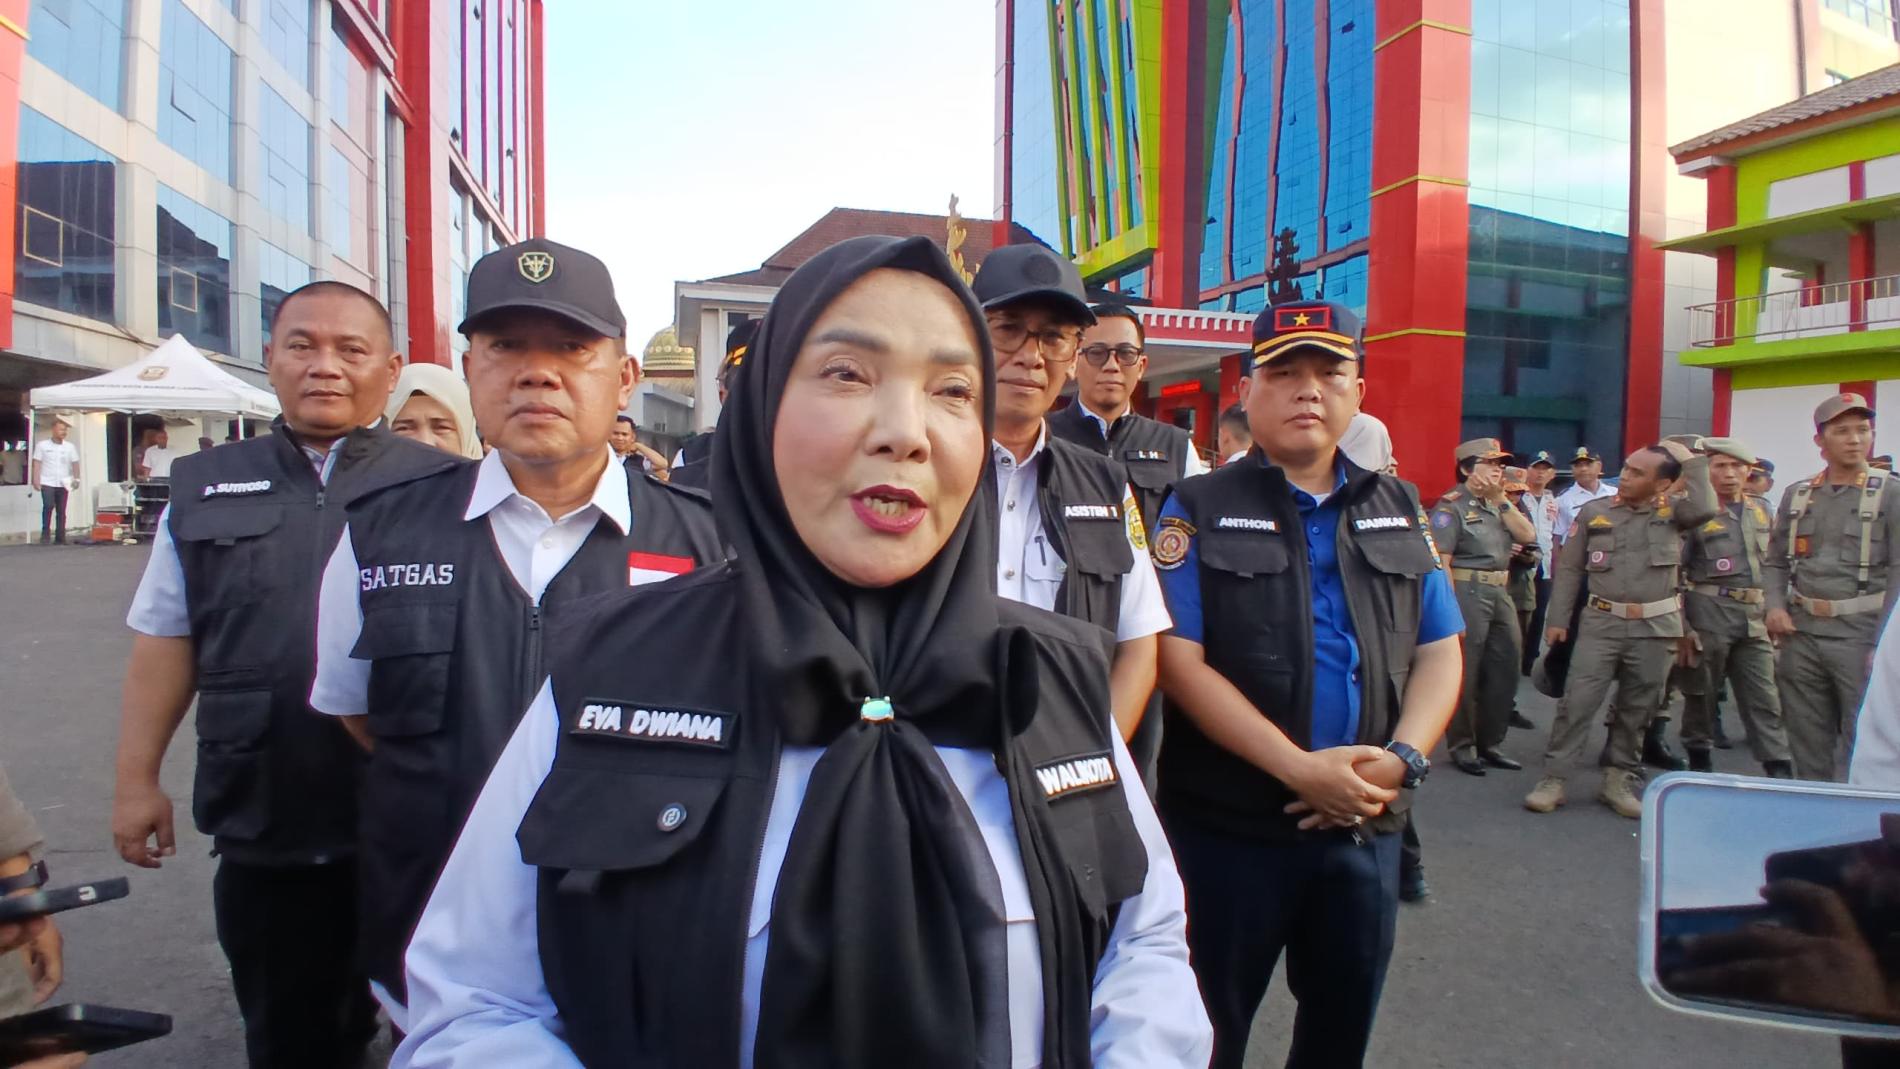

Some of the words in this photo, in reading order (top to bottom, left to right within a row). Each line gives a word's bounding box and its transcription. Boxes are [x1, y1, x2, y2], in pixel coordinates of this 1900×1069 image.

[361, 563, 454, 591] SATGAS
[579, 704, 622, 732] EVA
[629, 709, 723, 742] DWIANA
